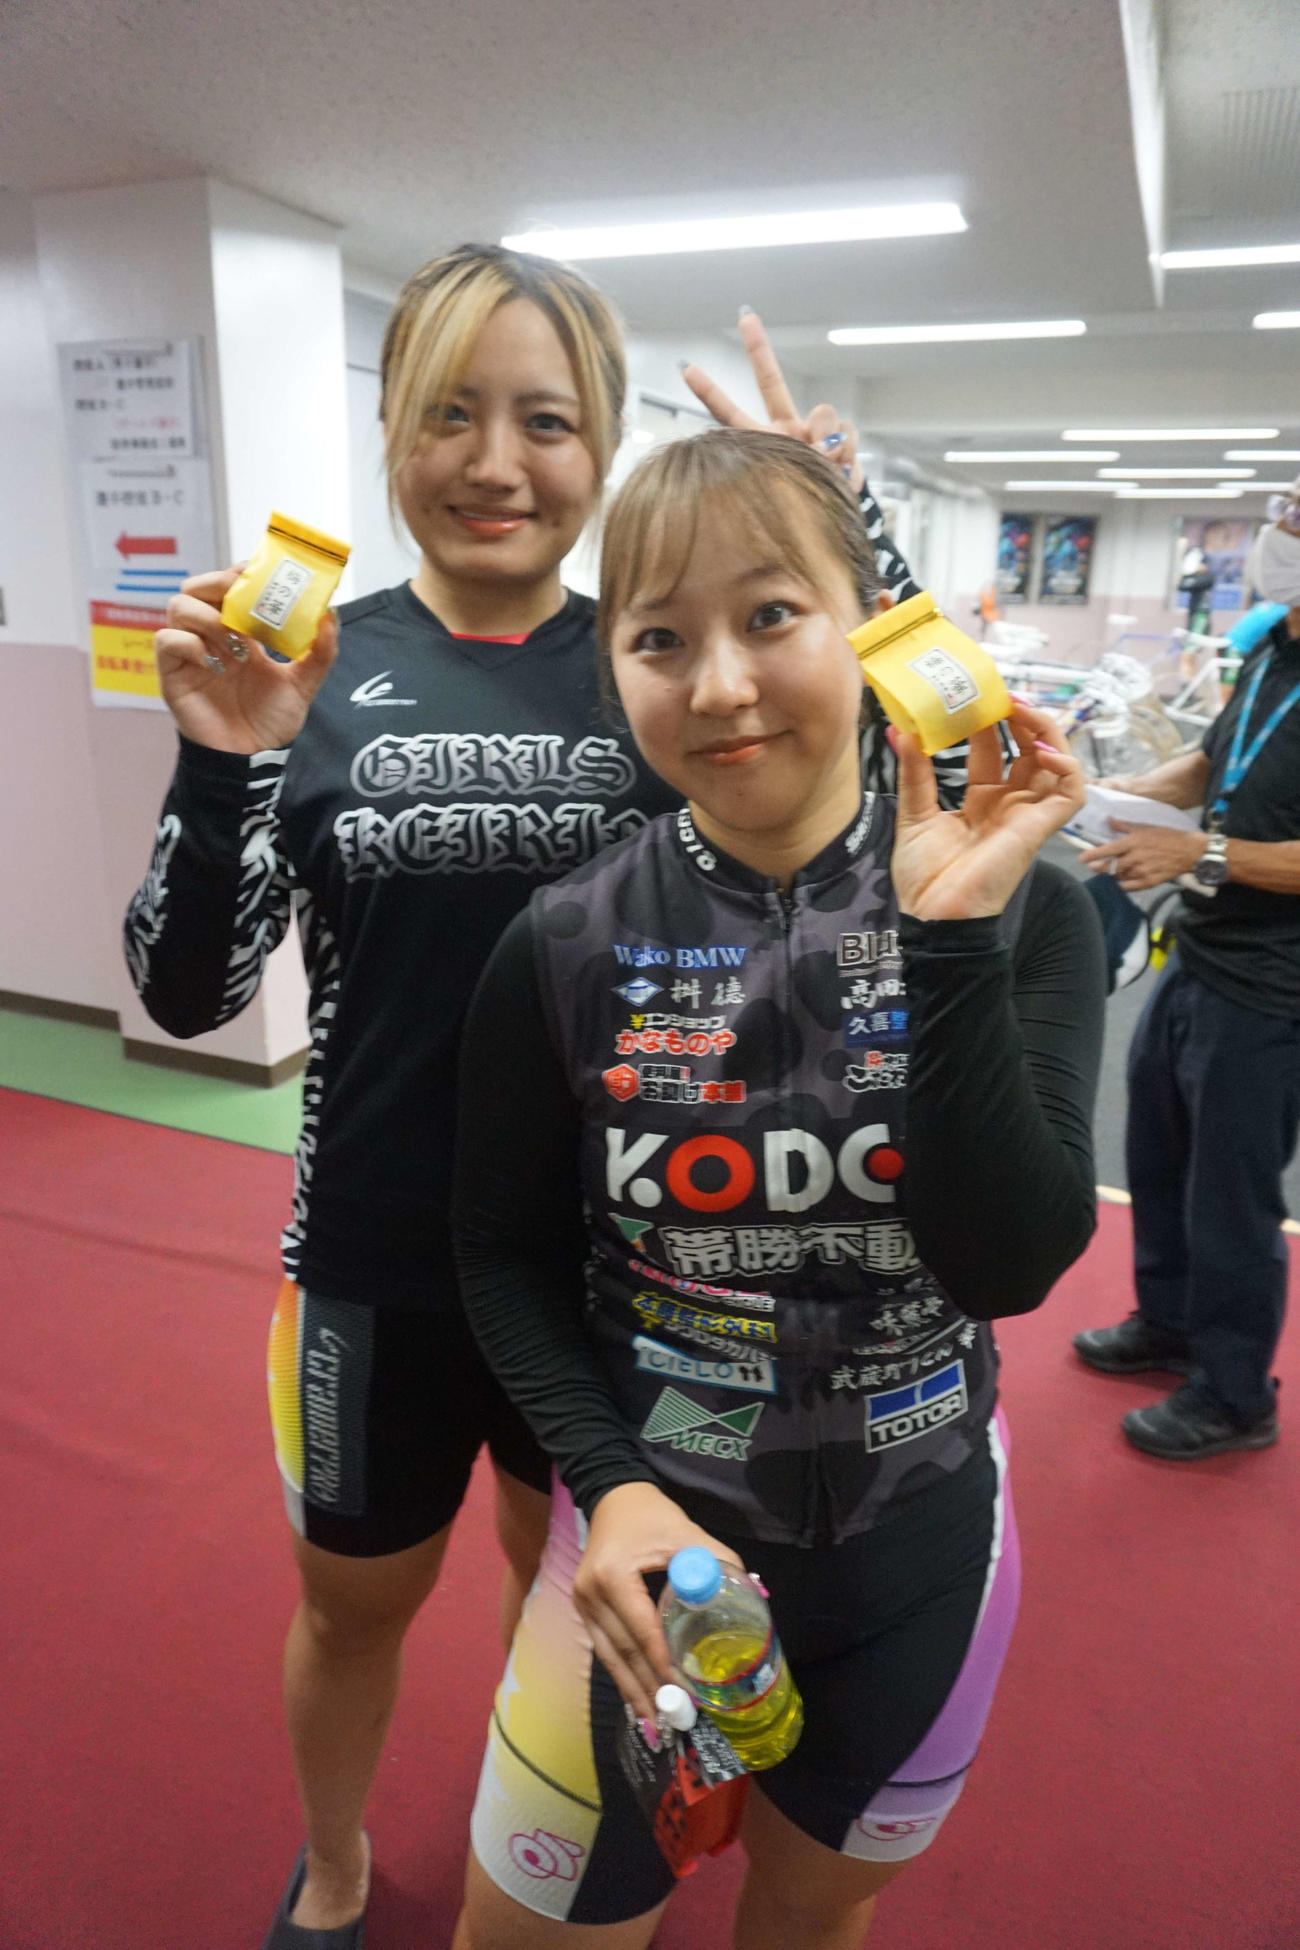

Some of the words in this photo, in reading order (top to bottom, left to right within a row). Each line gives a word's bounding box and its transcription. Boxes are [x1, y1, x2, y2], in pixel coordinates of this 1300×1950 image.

[350, 733, 637, 798] GIRLS
[612, 944, 671, 968] Wako
[676, 946, 748, 969] BMW
[614, 1028, 738, 1056] かなものや
[647, 1350, 735, 1379] CIELO
